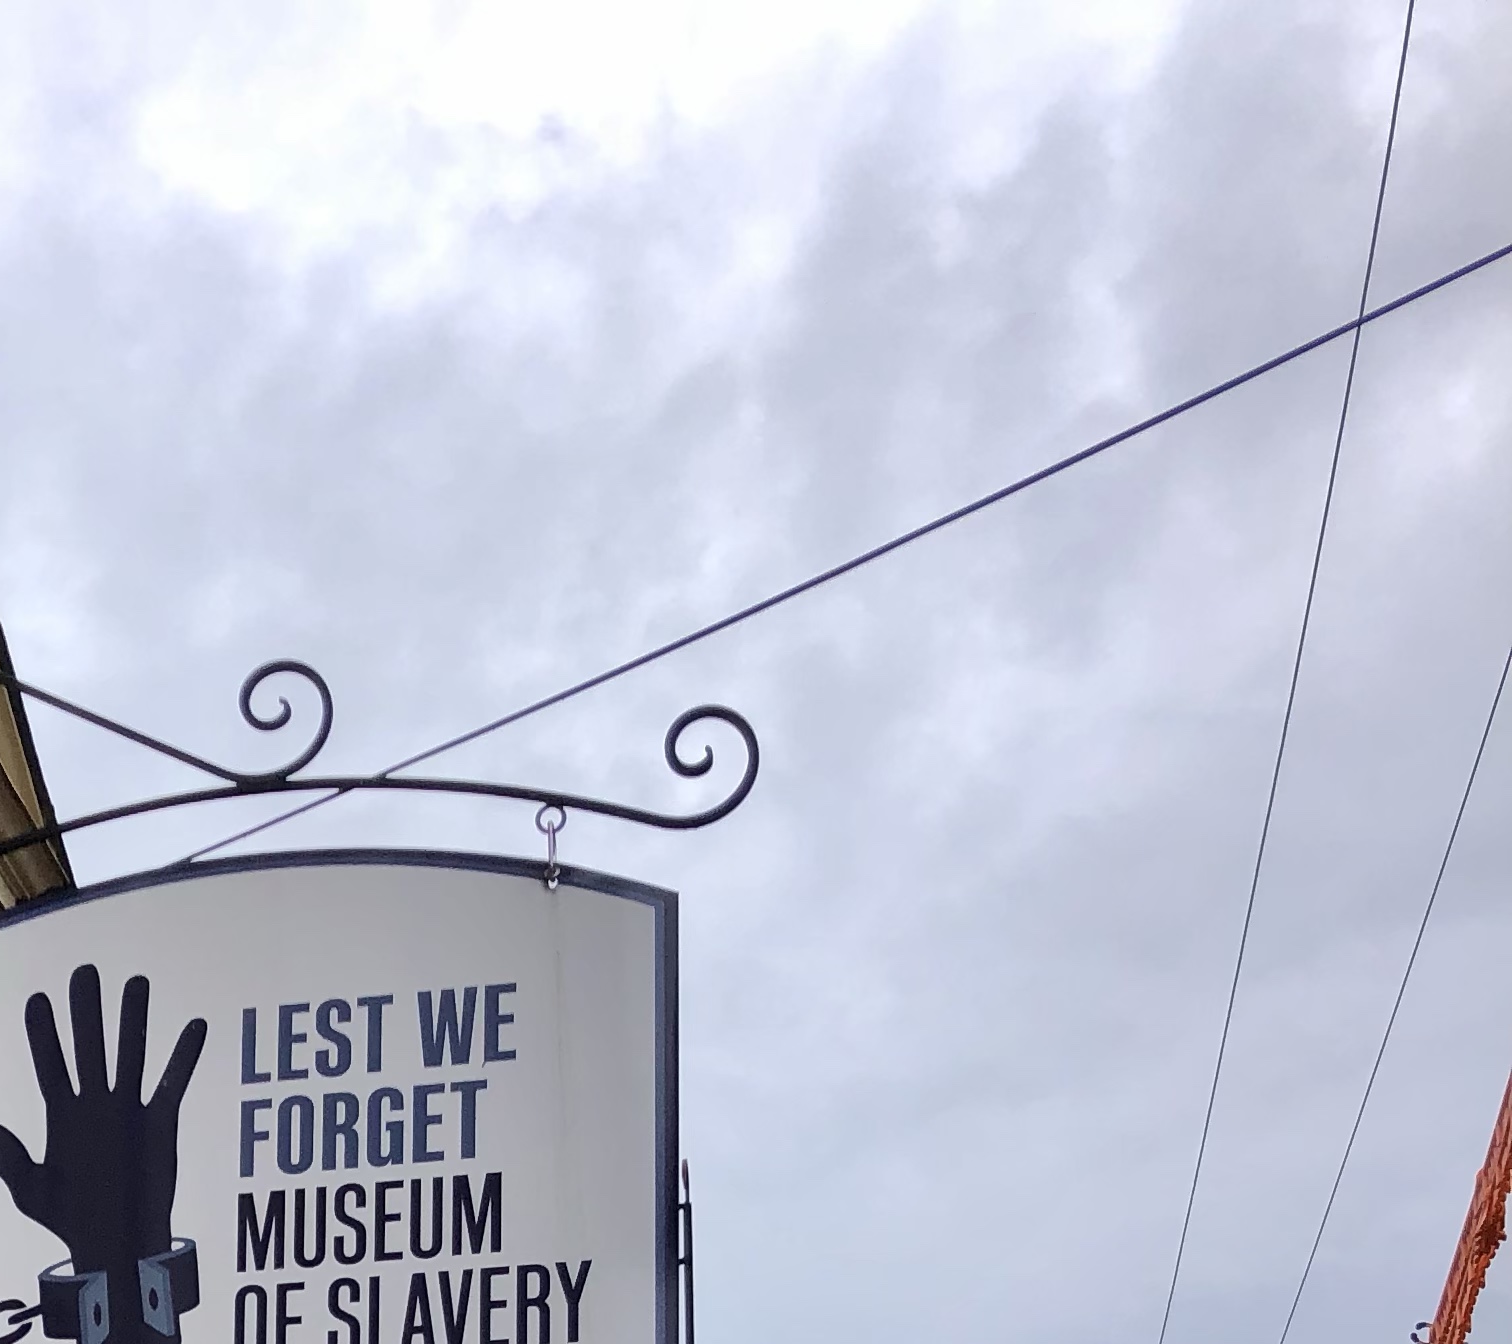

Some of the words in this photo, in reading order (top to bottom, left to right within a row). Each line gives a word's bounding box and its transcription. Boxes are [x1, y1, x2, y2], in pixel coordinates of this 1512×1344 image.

[241, 993, 394, 1085] LEST
[417, 983, 517, 1068] WE
[239, 1078, 488, 1179] FORGET
[236, 1171, 503, 1273] MUSEUM
